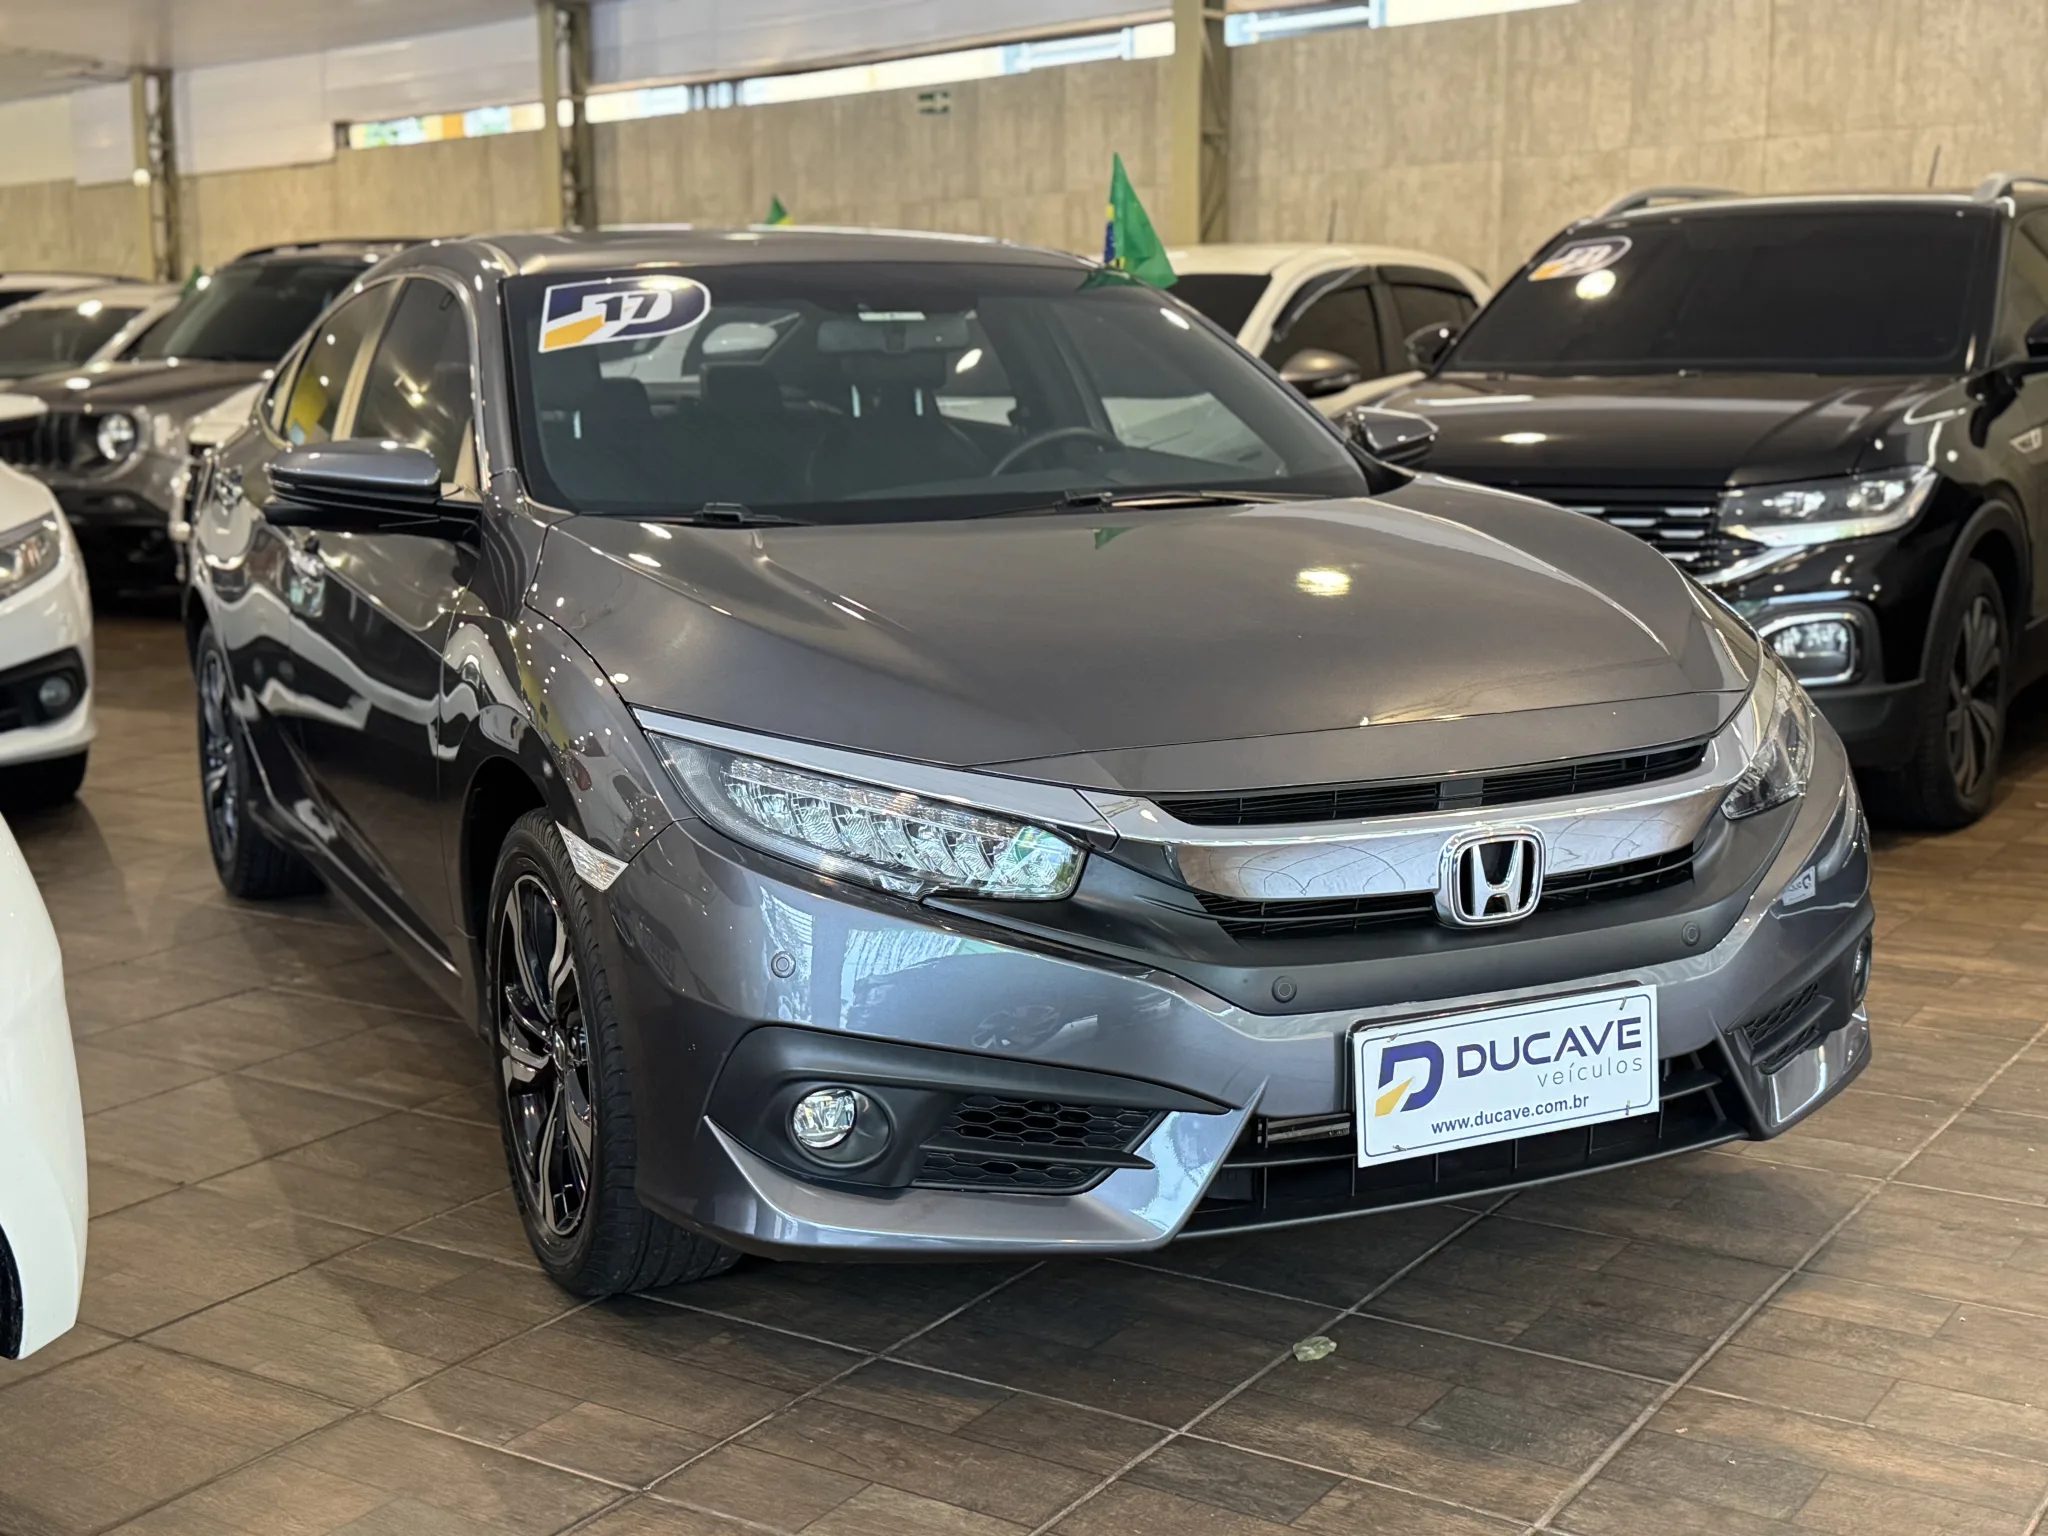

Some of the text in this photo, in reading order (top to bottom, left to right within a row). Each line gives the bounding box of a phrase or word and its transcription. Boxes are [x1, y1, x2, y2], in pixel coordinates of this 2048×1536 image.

[595, 293, 659, 323] 17
[1456, 1016, 1642, 1079] DUCAVE
[1537, 1056, 1643, 1088] veículos
[1431, 1094, 1590, 1134] www.ducave.com.br
